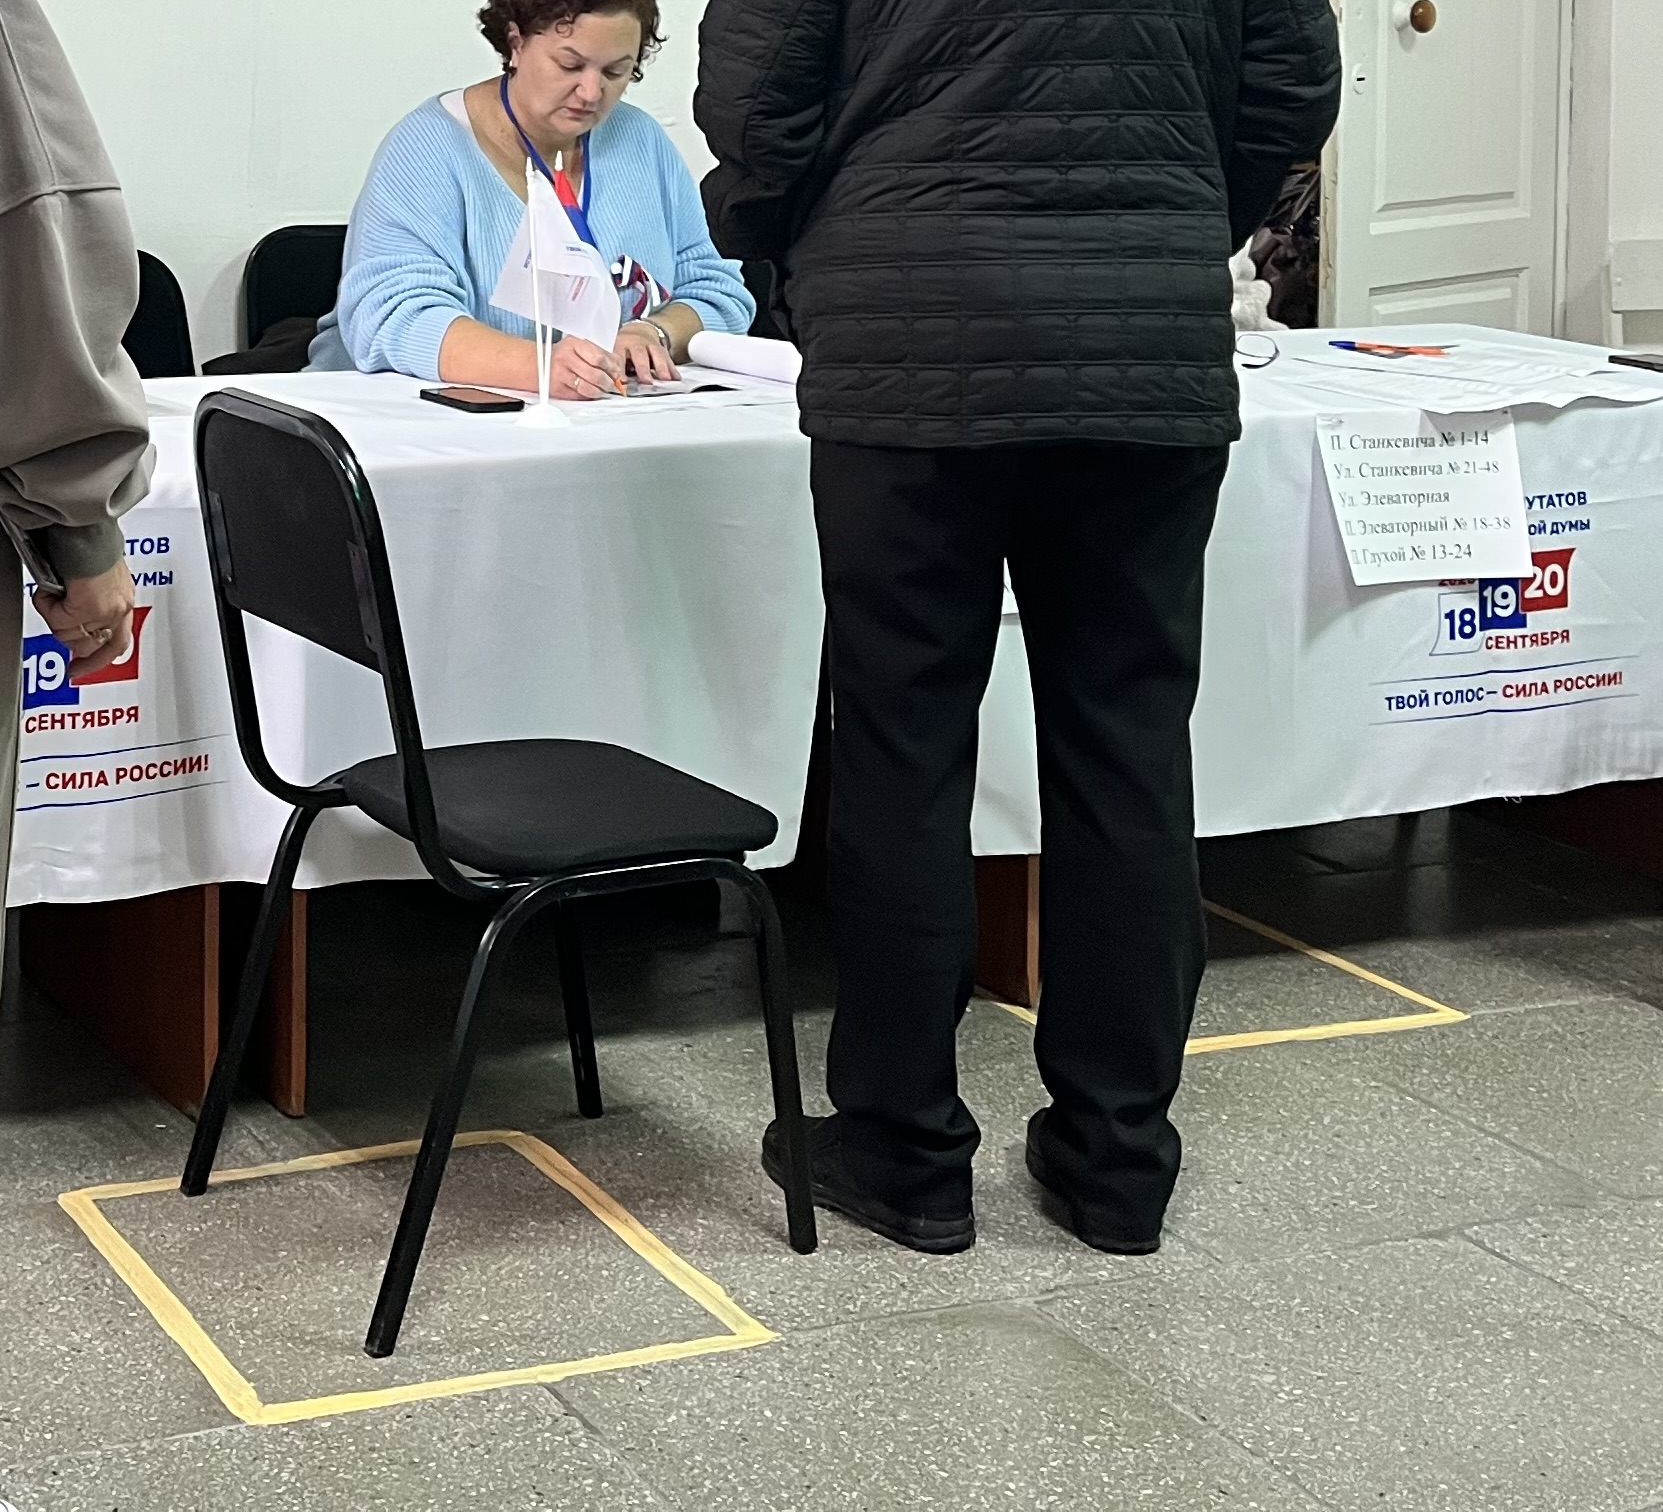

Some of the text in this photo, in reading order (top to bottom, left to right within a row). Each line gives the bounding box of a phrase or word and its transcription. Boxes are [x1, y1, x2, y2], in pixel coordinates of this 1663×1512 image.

[1349, 434, 1435, 450] Станкевича
[1439, 431, 1455, 447] №
[1461, 430, 1489, 446] 1-14
[1334, 460, 1500, 479] Ул. Станкевича № 21-48
[1361, 491, 1450, 508] Элеваторная
[1357, 516, 1448, 536] Элеваторный
[1453, 517, 1468, 532] №
[1473, 516, 1512, 531] 18-38
[1550, 518, 1591, 536] ДУМЫ
[1409, 545, 1426, 561] №
[1432, 543, 1472, 560] 13-24
[1523, 562, 1565, 600] 20
[1482, 584, 1517, 619] 19
[1444, 607, 1477, 641] 18
[1485, 629, 1570, 651] СЕНТЯБРЯ
[22, 651, 66, 695] 19
[1384, 689, 1430, 711] ТВОЙ
[1435, 686, 1485, 707] ГОЛОС
[1502, 681, 1549, 699] СИЛА
[1553, 670, 1624, 694] РОССИИ!
[25, 705, 139, 734] СЕНТЯБРЯ
[45, 769, 109, 791] СИЛА
[115, 753, 210, 786] РОССИИ!
